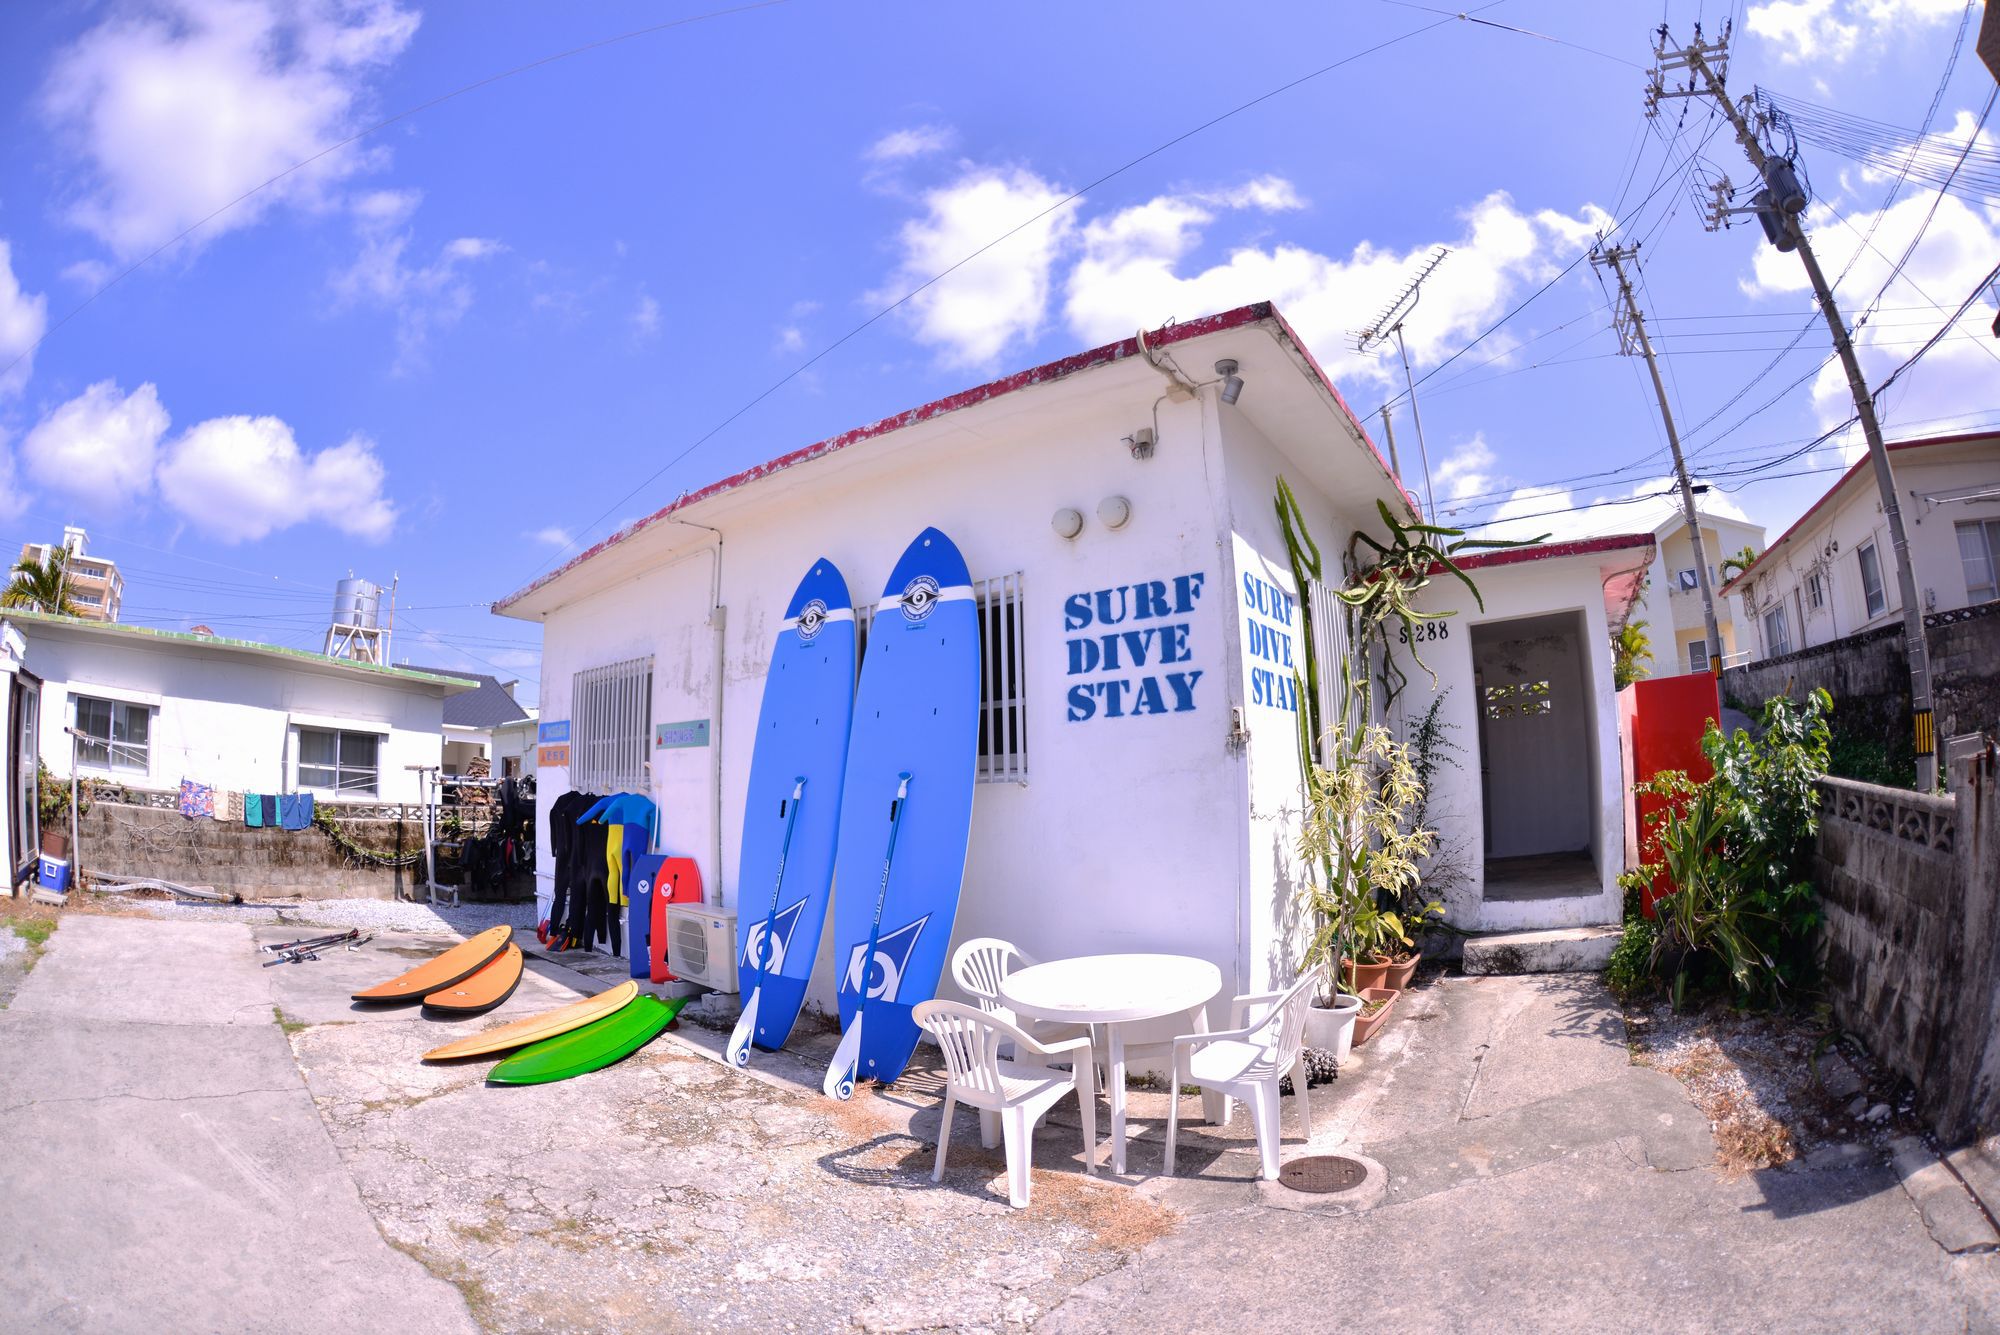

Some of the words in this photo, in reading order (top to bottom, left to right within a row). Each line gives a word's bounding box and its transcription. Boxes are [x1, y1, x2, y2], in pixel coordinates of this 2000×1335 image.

[1064, 572, 1205, 632] SURF
[1243, 571, 1294, 628] SURF
[1066, 623, 1192, 675] DIVE
[1247, 617, 1294, 668] DIVE
[1067, 670, 1203, 722] STAY
[1252, 666, 1297, 712] STAY
